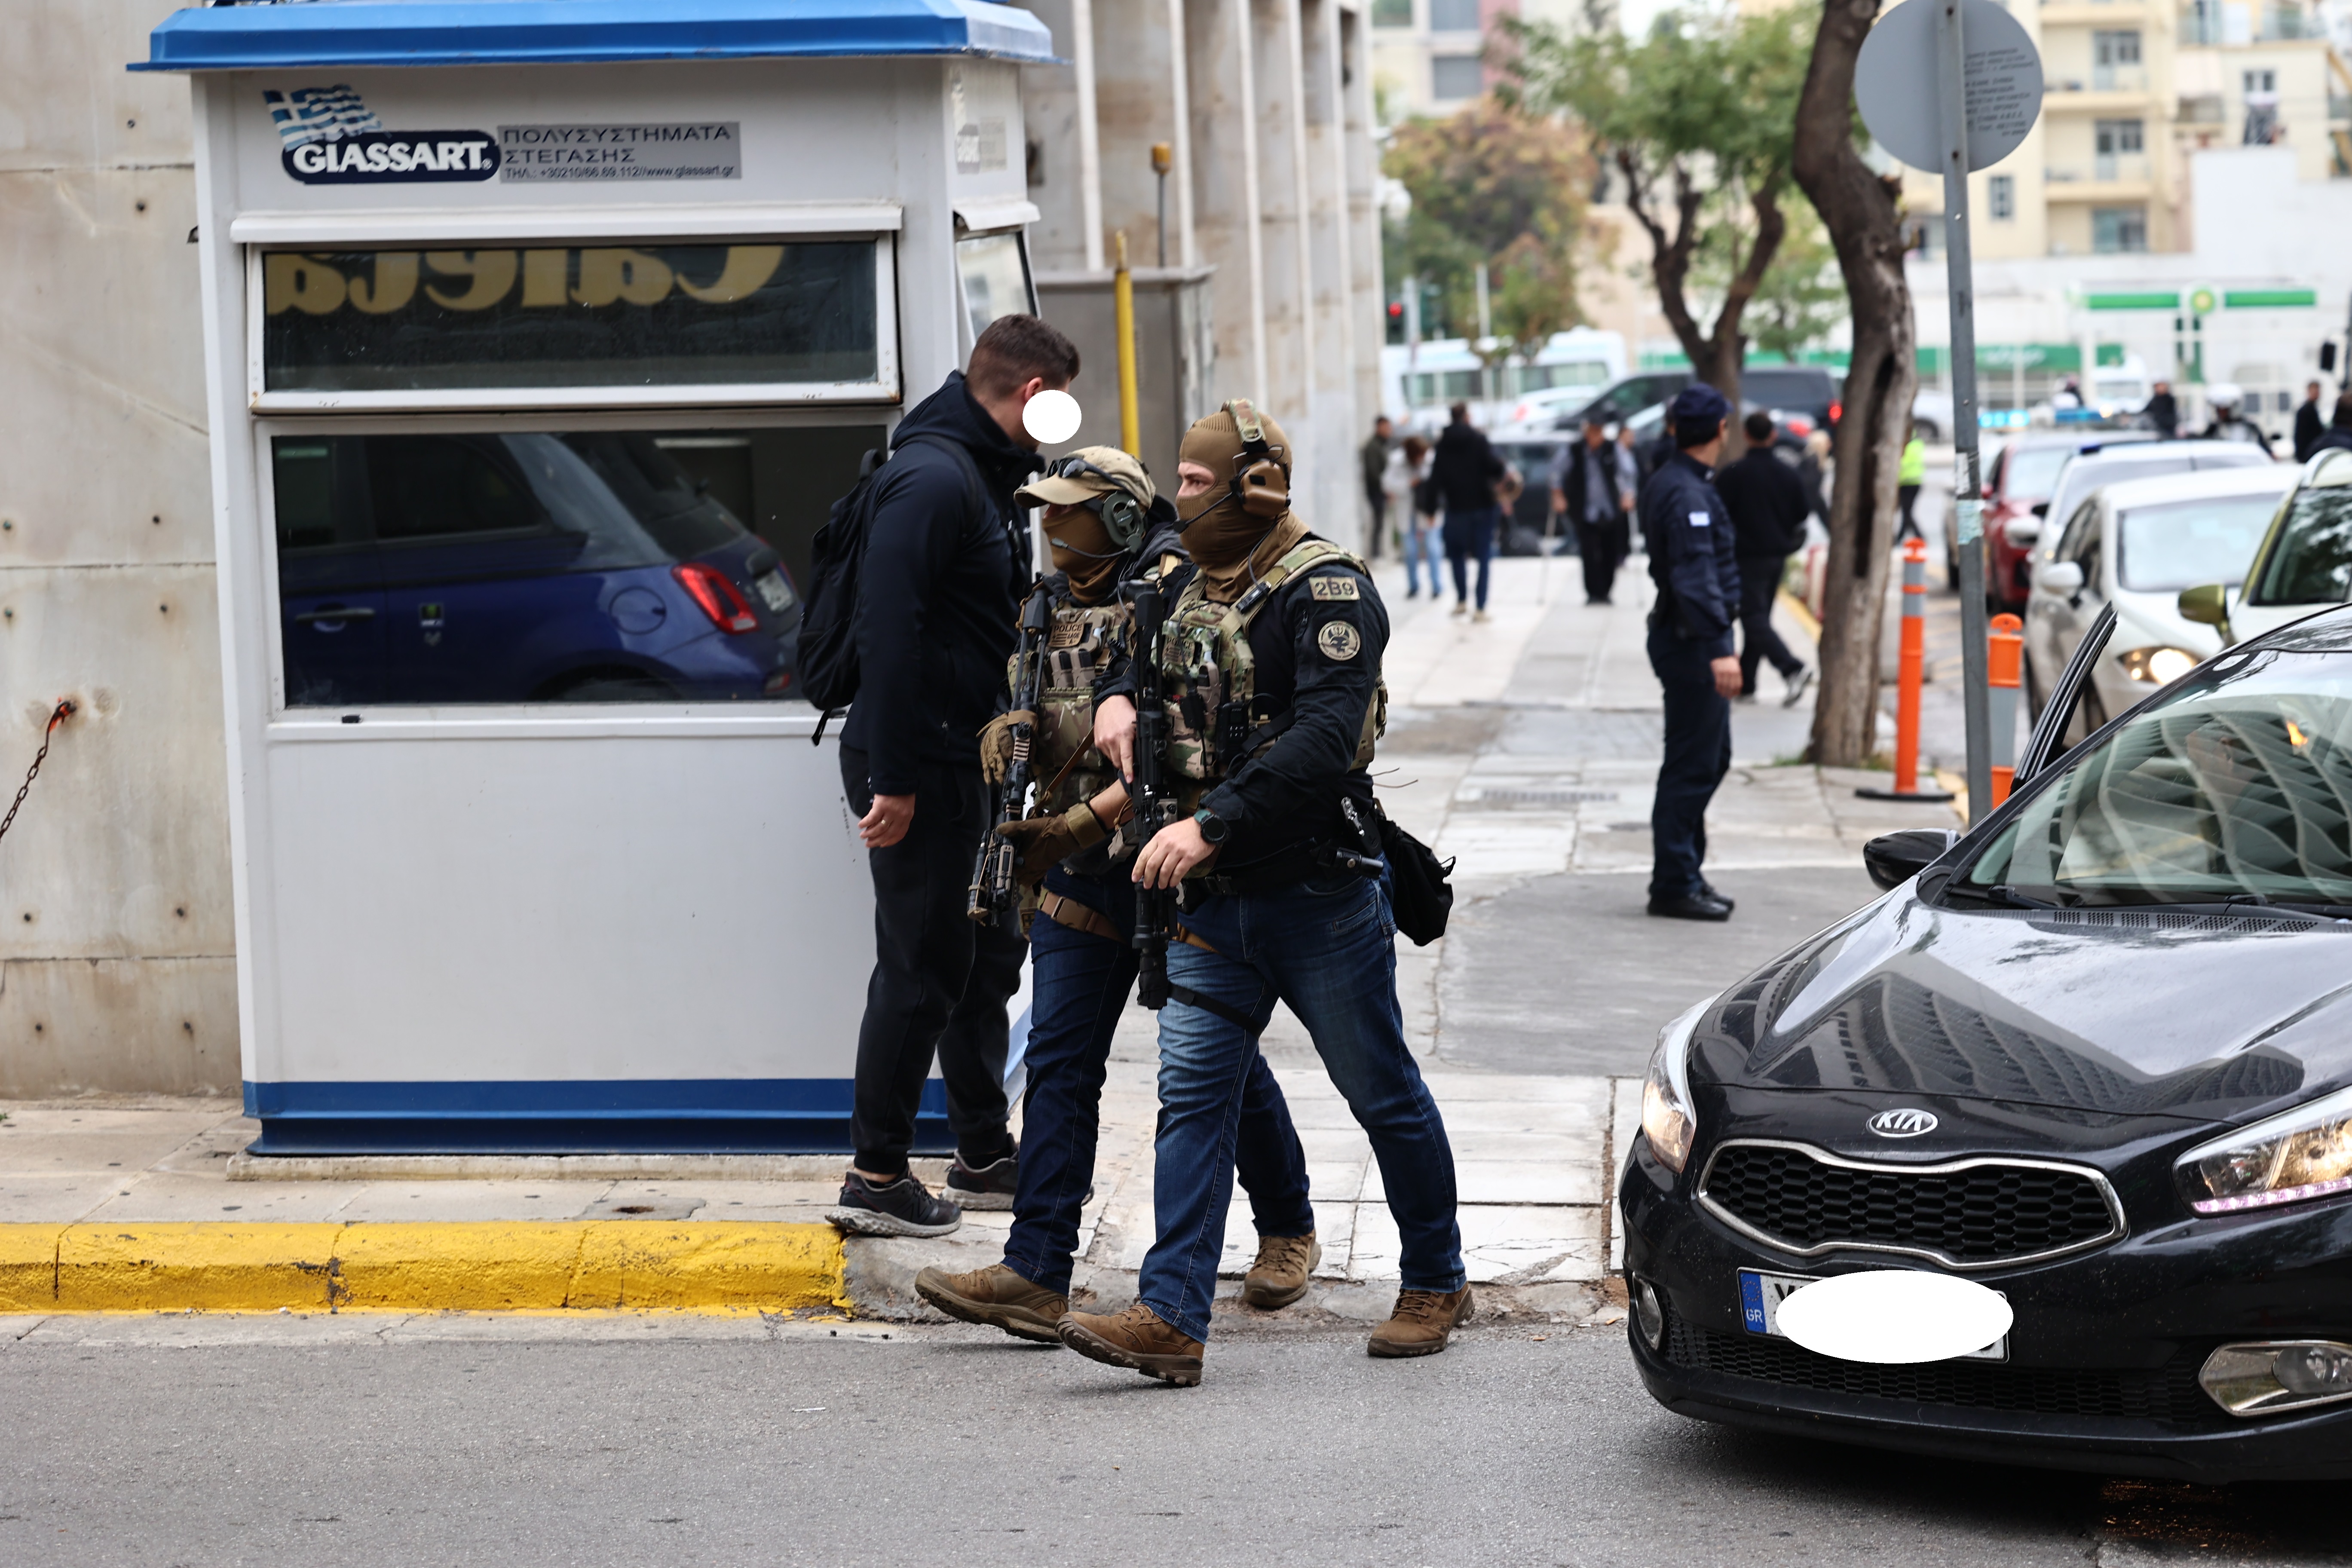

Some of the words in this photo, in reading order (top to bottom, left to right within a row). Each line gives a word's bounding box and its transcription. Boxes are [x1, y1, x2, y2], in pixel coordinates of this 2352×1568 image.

[504, 125, 731, 144] ΠΟΛΥΣΥΣΤΗΜΑΤΑ
[293, 141, 488, 174] GLASSART
[504, 148, 635, 164] ΣΤΕΓΑΣΗΣ
[1315, 581, 1354, 596] 2B9
[1054, 623, 1082, 633] POLICE
[1876, 1112, 1923, 1132] KIA
[1746, 1308, 1763, 1323] GR
